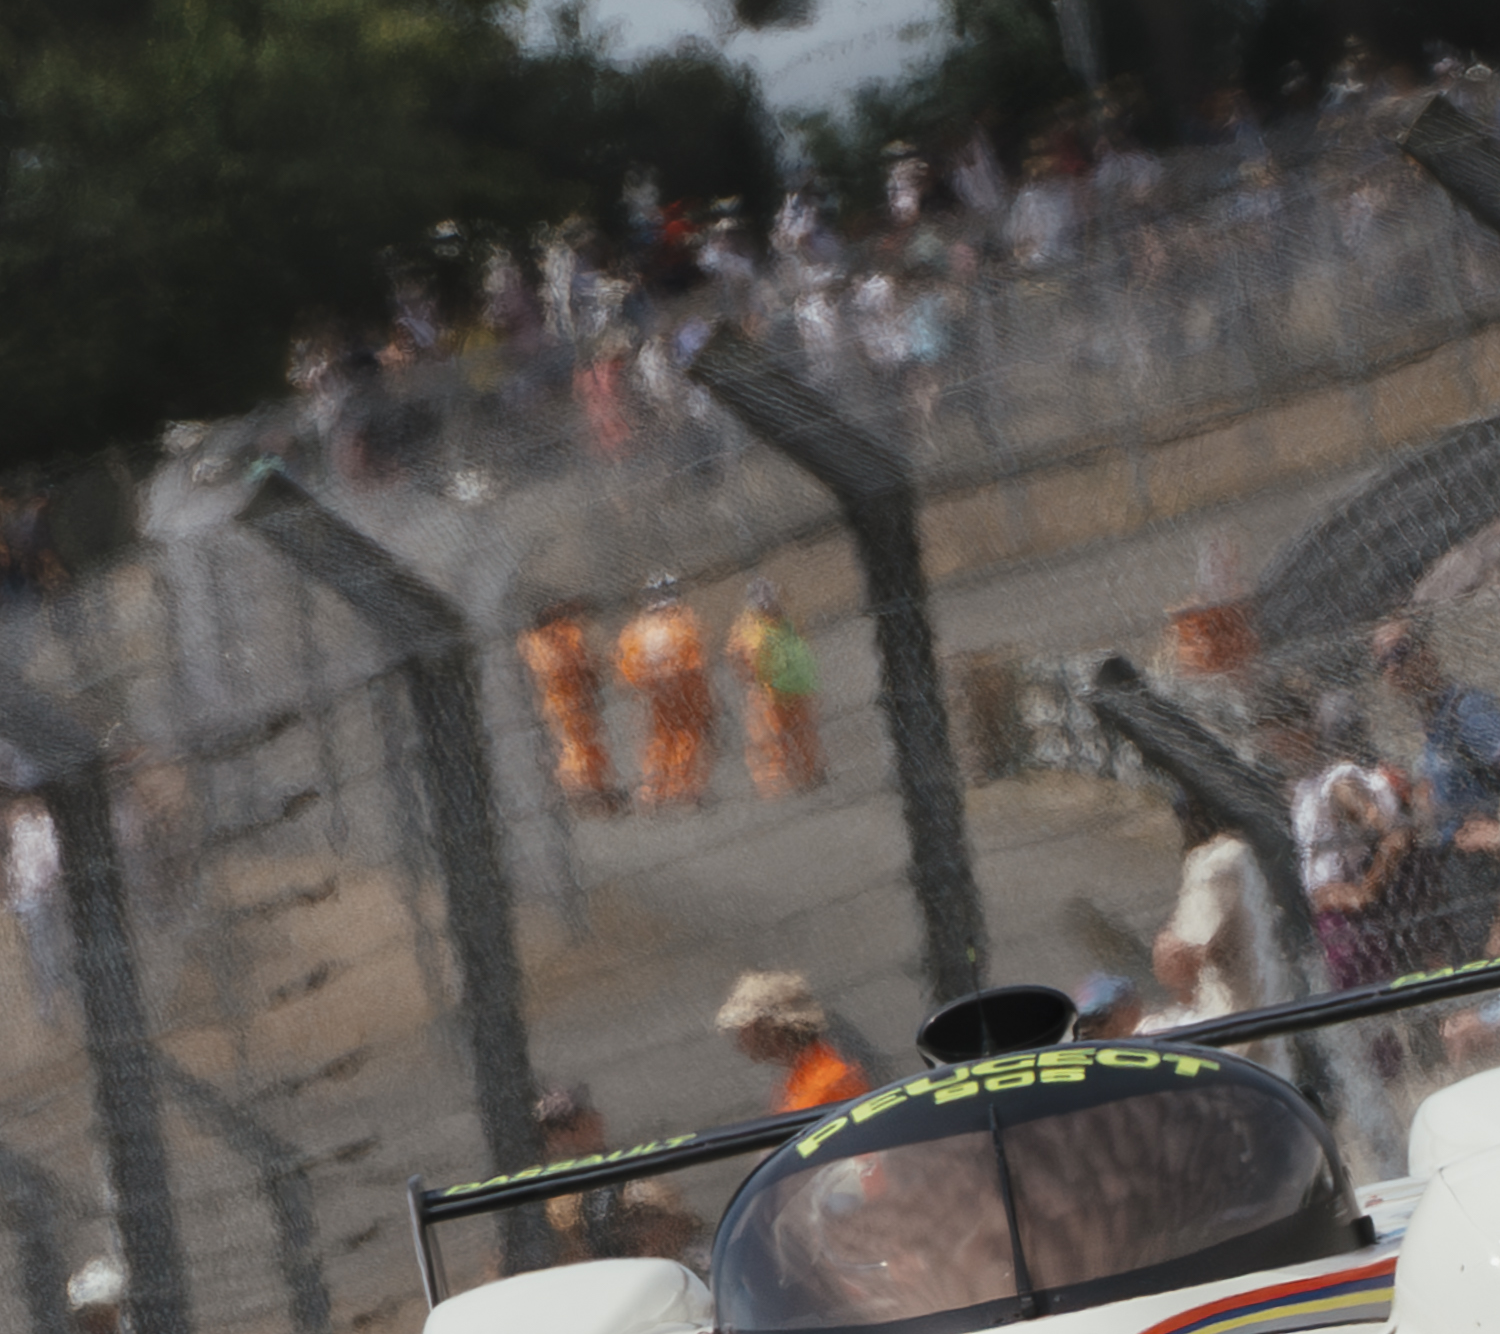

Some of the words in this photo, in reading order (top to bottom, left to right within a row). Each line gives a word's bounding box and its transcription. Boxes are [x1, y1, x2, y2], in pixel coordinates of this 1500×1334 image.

[796, 1047, 1220, 1158] PEUGEOT
[934, 1067, 1086, 1105] 905
[444, 1132, 697, 1197] DASSAULT
